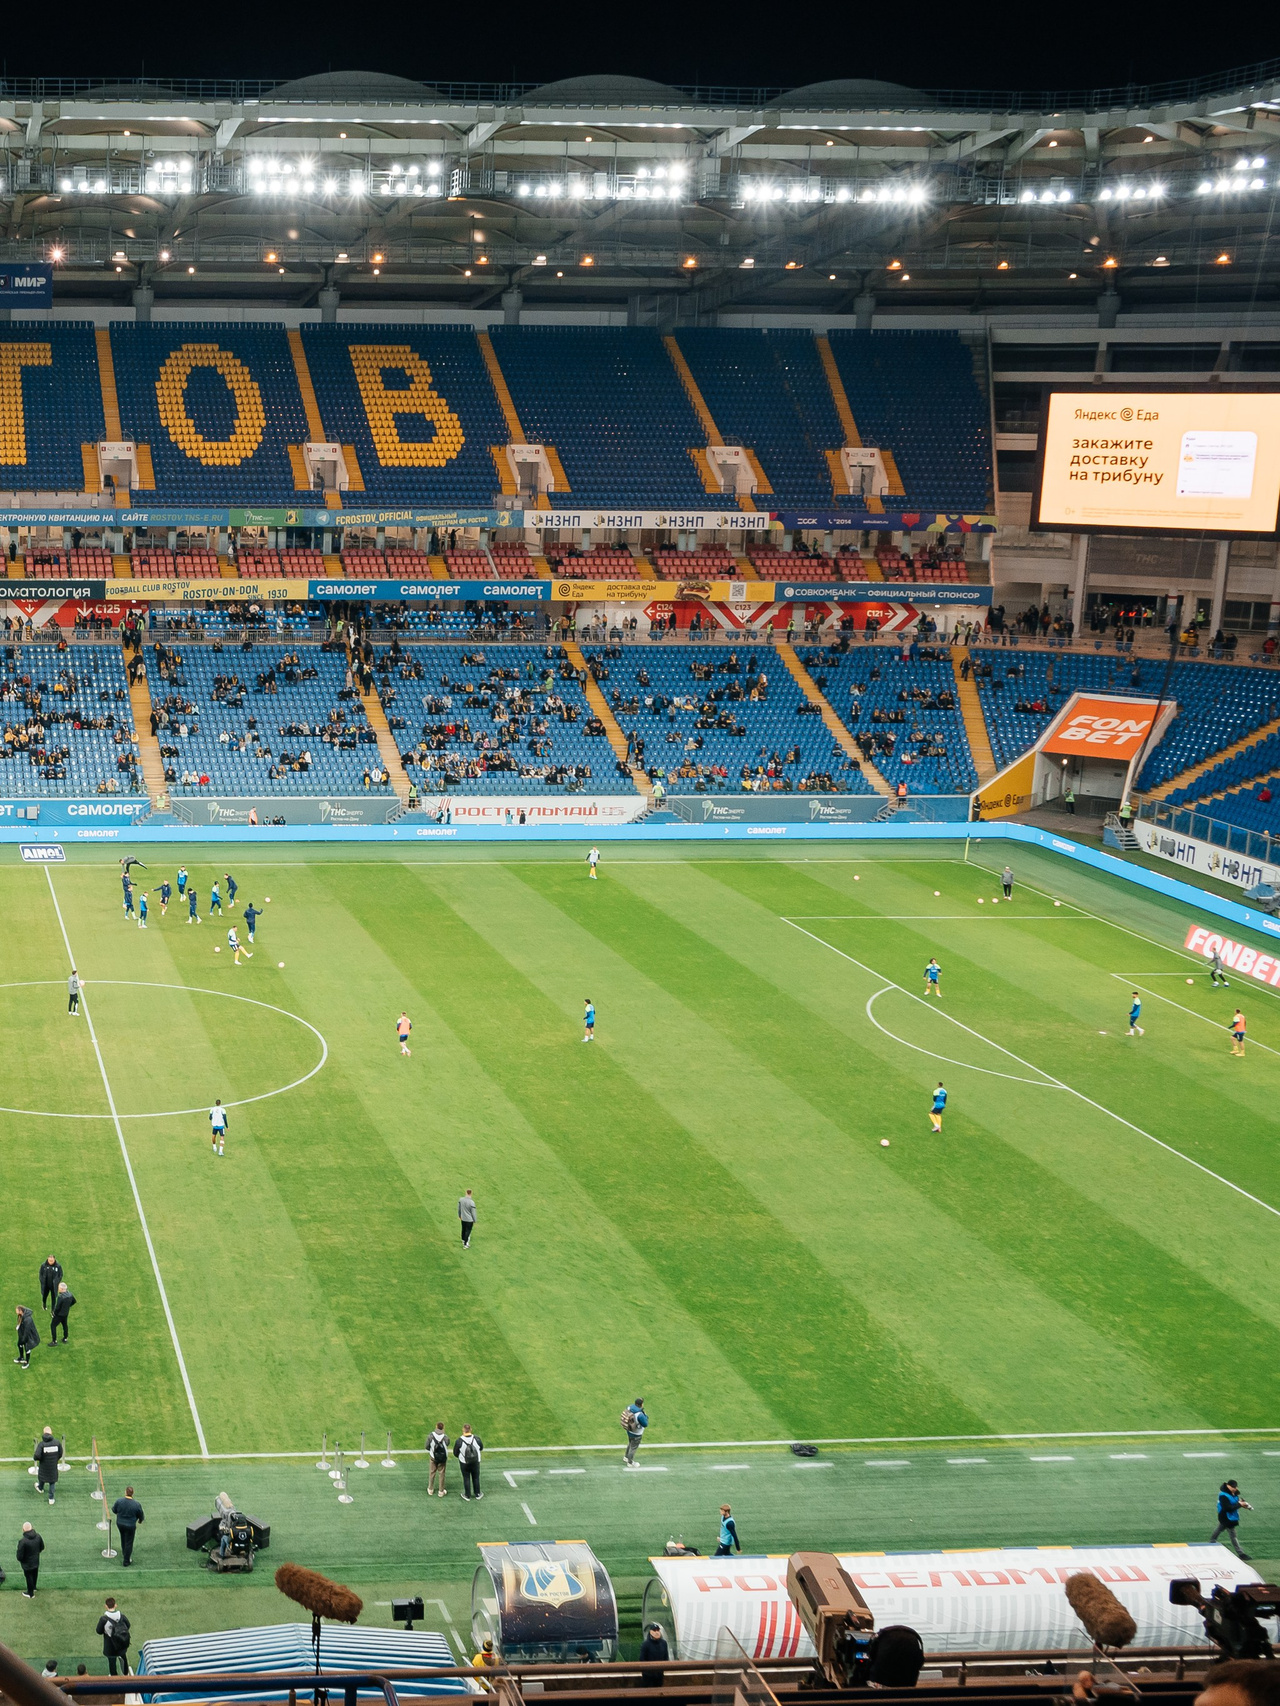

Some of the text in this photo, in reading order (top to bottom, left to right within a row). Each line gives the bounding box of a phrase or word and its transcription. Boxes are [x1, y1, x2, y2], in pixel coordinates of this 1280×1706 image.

[14, 277, 46, 288] МИР
[1074, 408, 1159, 421] Яндекс Еда
[1072, 439, 1153, 450] закажите
[1070, 455, 1149, 468] доставку
[1069, 469, 1164, 486] на трибуну
[48, 514, 100, 523] КВИТАНЦИЮ
[102, 514, 114, 522] НА
[122, 512, 148, 521] САЙТЕ
[336, 511, 413, 525] FCROSTOV_OFFICIAL
[416, 512, 457, 522] ОФИЦИАЛЬНЫЙ
[545, 516, 580, 526] НЗНП
[607, 516, 642, 527] НЗНП
[669, 516, 704, 527] НЗНП
[730, 517, 765, 528] НЗНП
[106, 582, 190, 595] FOOTBALL CLUB ROSTOV
[183, 585, 258, 600] ROSTOV-ON-DON
[268, 589, 288, 599] 1930
[316, 585, 377, 595] самолет
[400, 585, 460, 595] самолет
[484, 585, 543, 595] самолет
[867, 589, 936, 598] ОФИЦИАЛЬНЫЙ
[938, 591, 980, 599] СПОНСОР
[96, 604, 120, 614] C125
[1068, 715, 1151, 732] FON
[1058, 728, 1142, 745] BET
[67, 804, 142, 816] самолет
[330, 808, 347, 816] ТНС
[454, 806, 598, 816] РОСТСЕЛЬМАШ
[77, 829, 119, 837] самолет
[417, 828, 457, 836] самолет
[23, 848, 63, 859] AIMOL
[692, 1565, 1151, 1592] РОСЕЛЬМАШ
